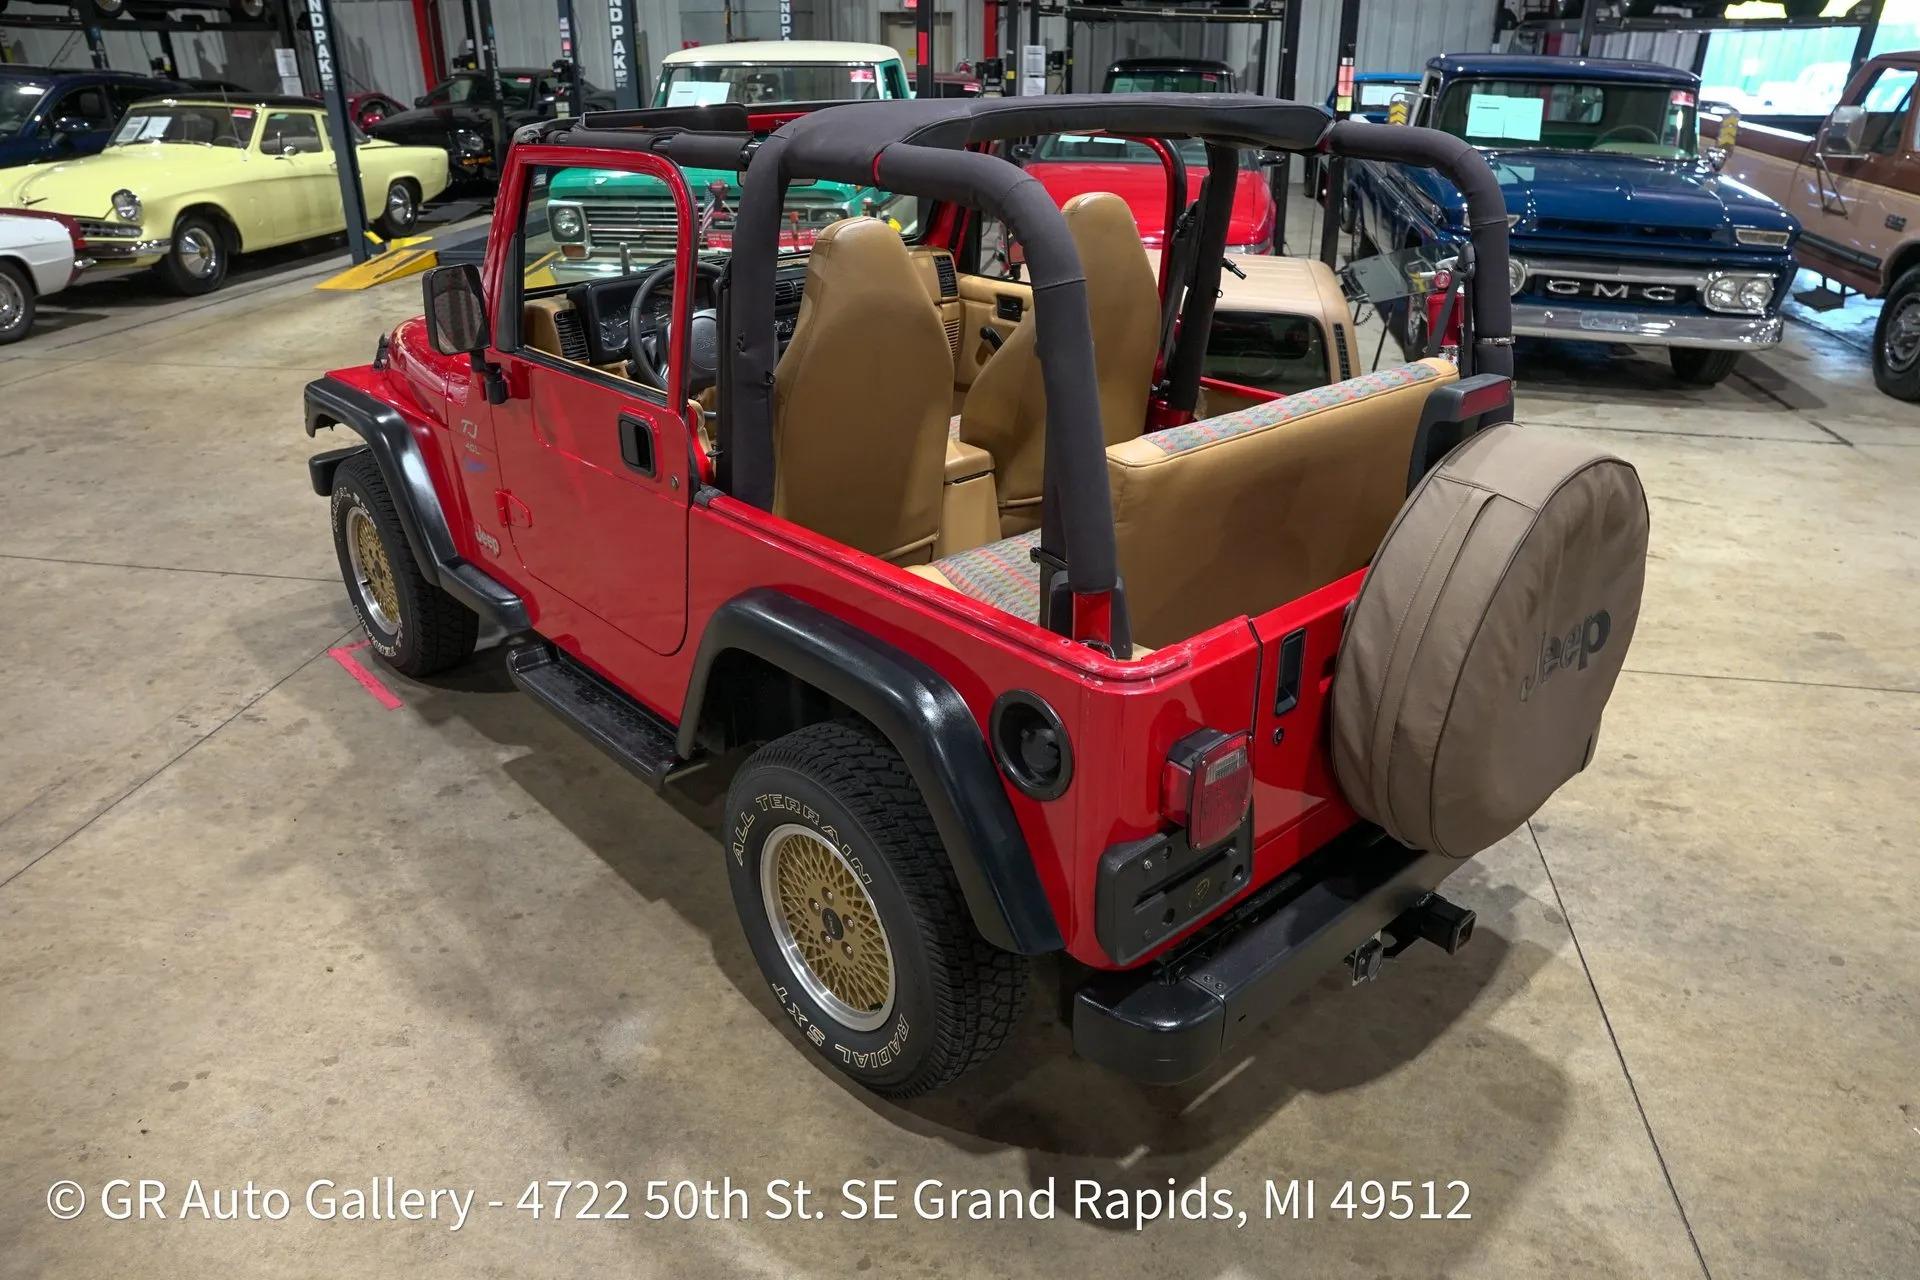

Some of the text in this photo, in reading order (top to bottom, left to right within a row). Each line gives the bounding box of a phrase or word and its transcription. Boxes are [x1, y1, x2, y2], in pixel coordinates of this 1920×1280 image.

[1545, 279, 1677, 301] GMC
[1519, 608, 1612, 703] Jeep
[731, 793, 873, 886] ALL TERRAIN
[771, 982, 911, 1069] RADIAL SXT
